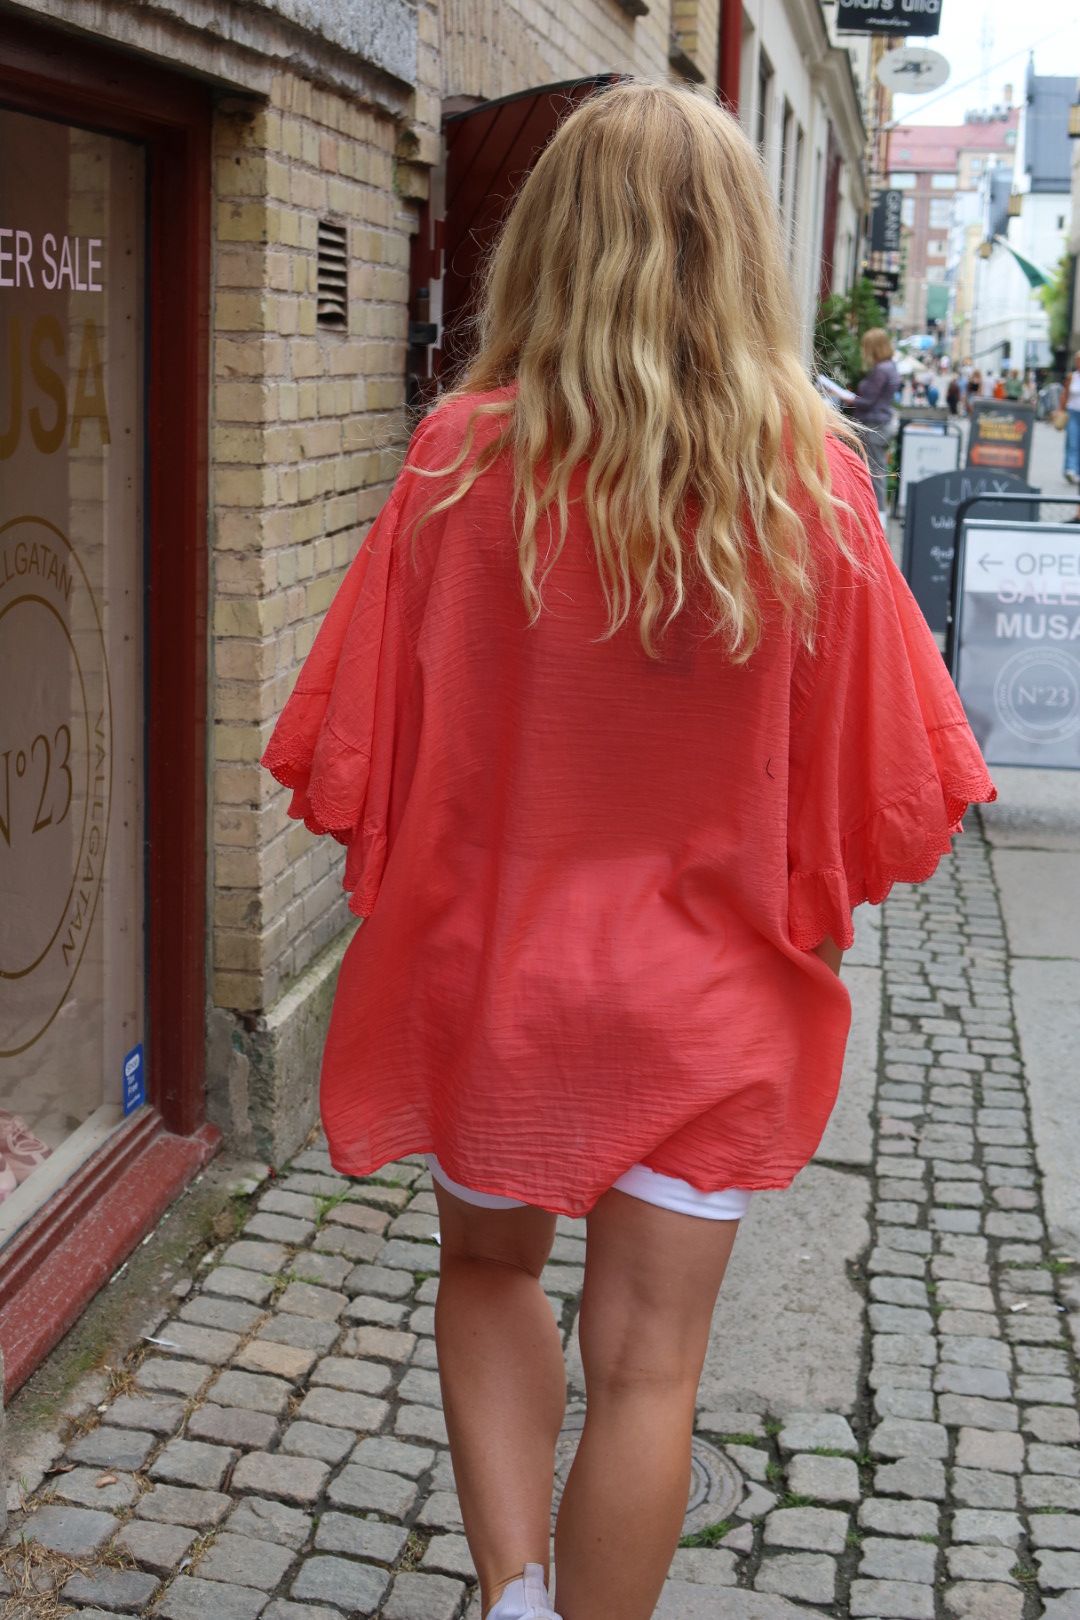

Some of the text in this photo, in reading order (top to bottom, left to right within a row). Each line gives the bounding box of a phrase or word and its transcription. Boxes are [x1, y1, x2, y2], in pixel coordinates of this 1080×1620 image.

[41, 233, 103, 291] SALE
[0, 542, 73, 602] LGATAN
[1015, 552, 1080, 577] OPE
[996, 577, 1080, 606] SALE
